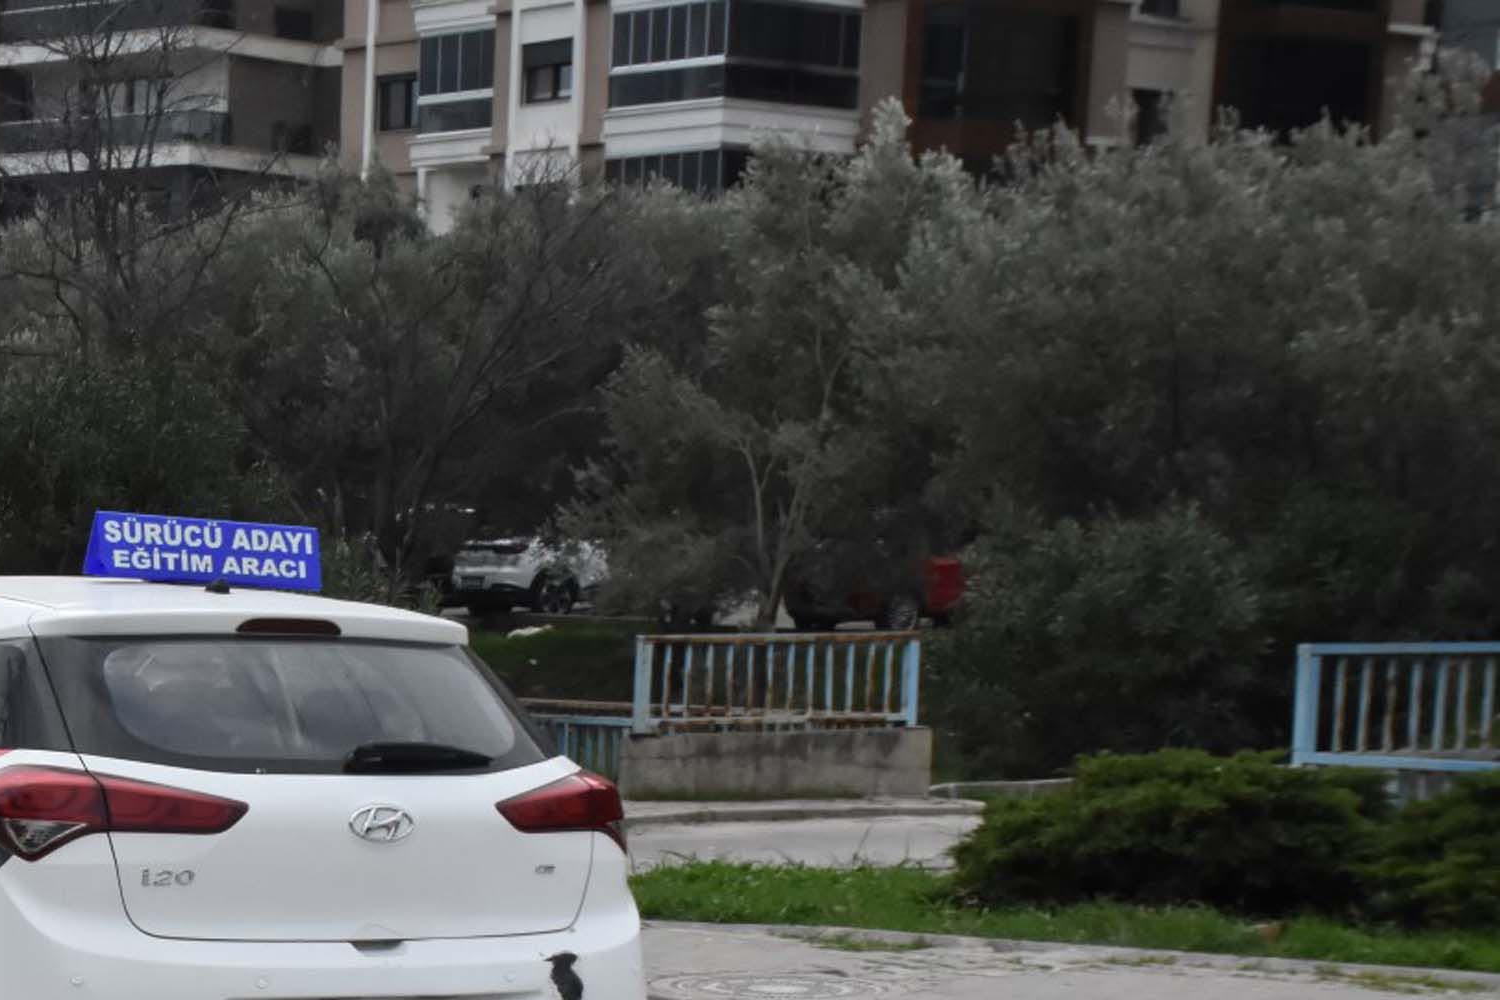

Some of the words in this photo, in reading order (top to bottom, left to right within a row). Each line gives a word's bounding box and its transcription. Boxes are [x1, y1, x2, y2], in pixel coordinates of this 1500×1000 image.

[103, 517, 222, 549] SÜRÜCÜ
[232, 529, 313, 554] ADAYI
[113, 547, 213, 573] EĞİTİM
[222, 557, 306, 578] ARACI
